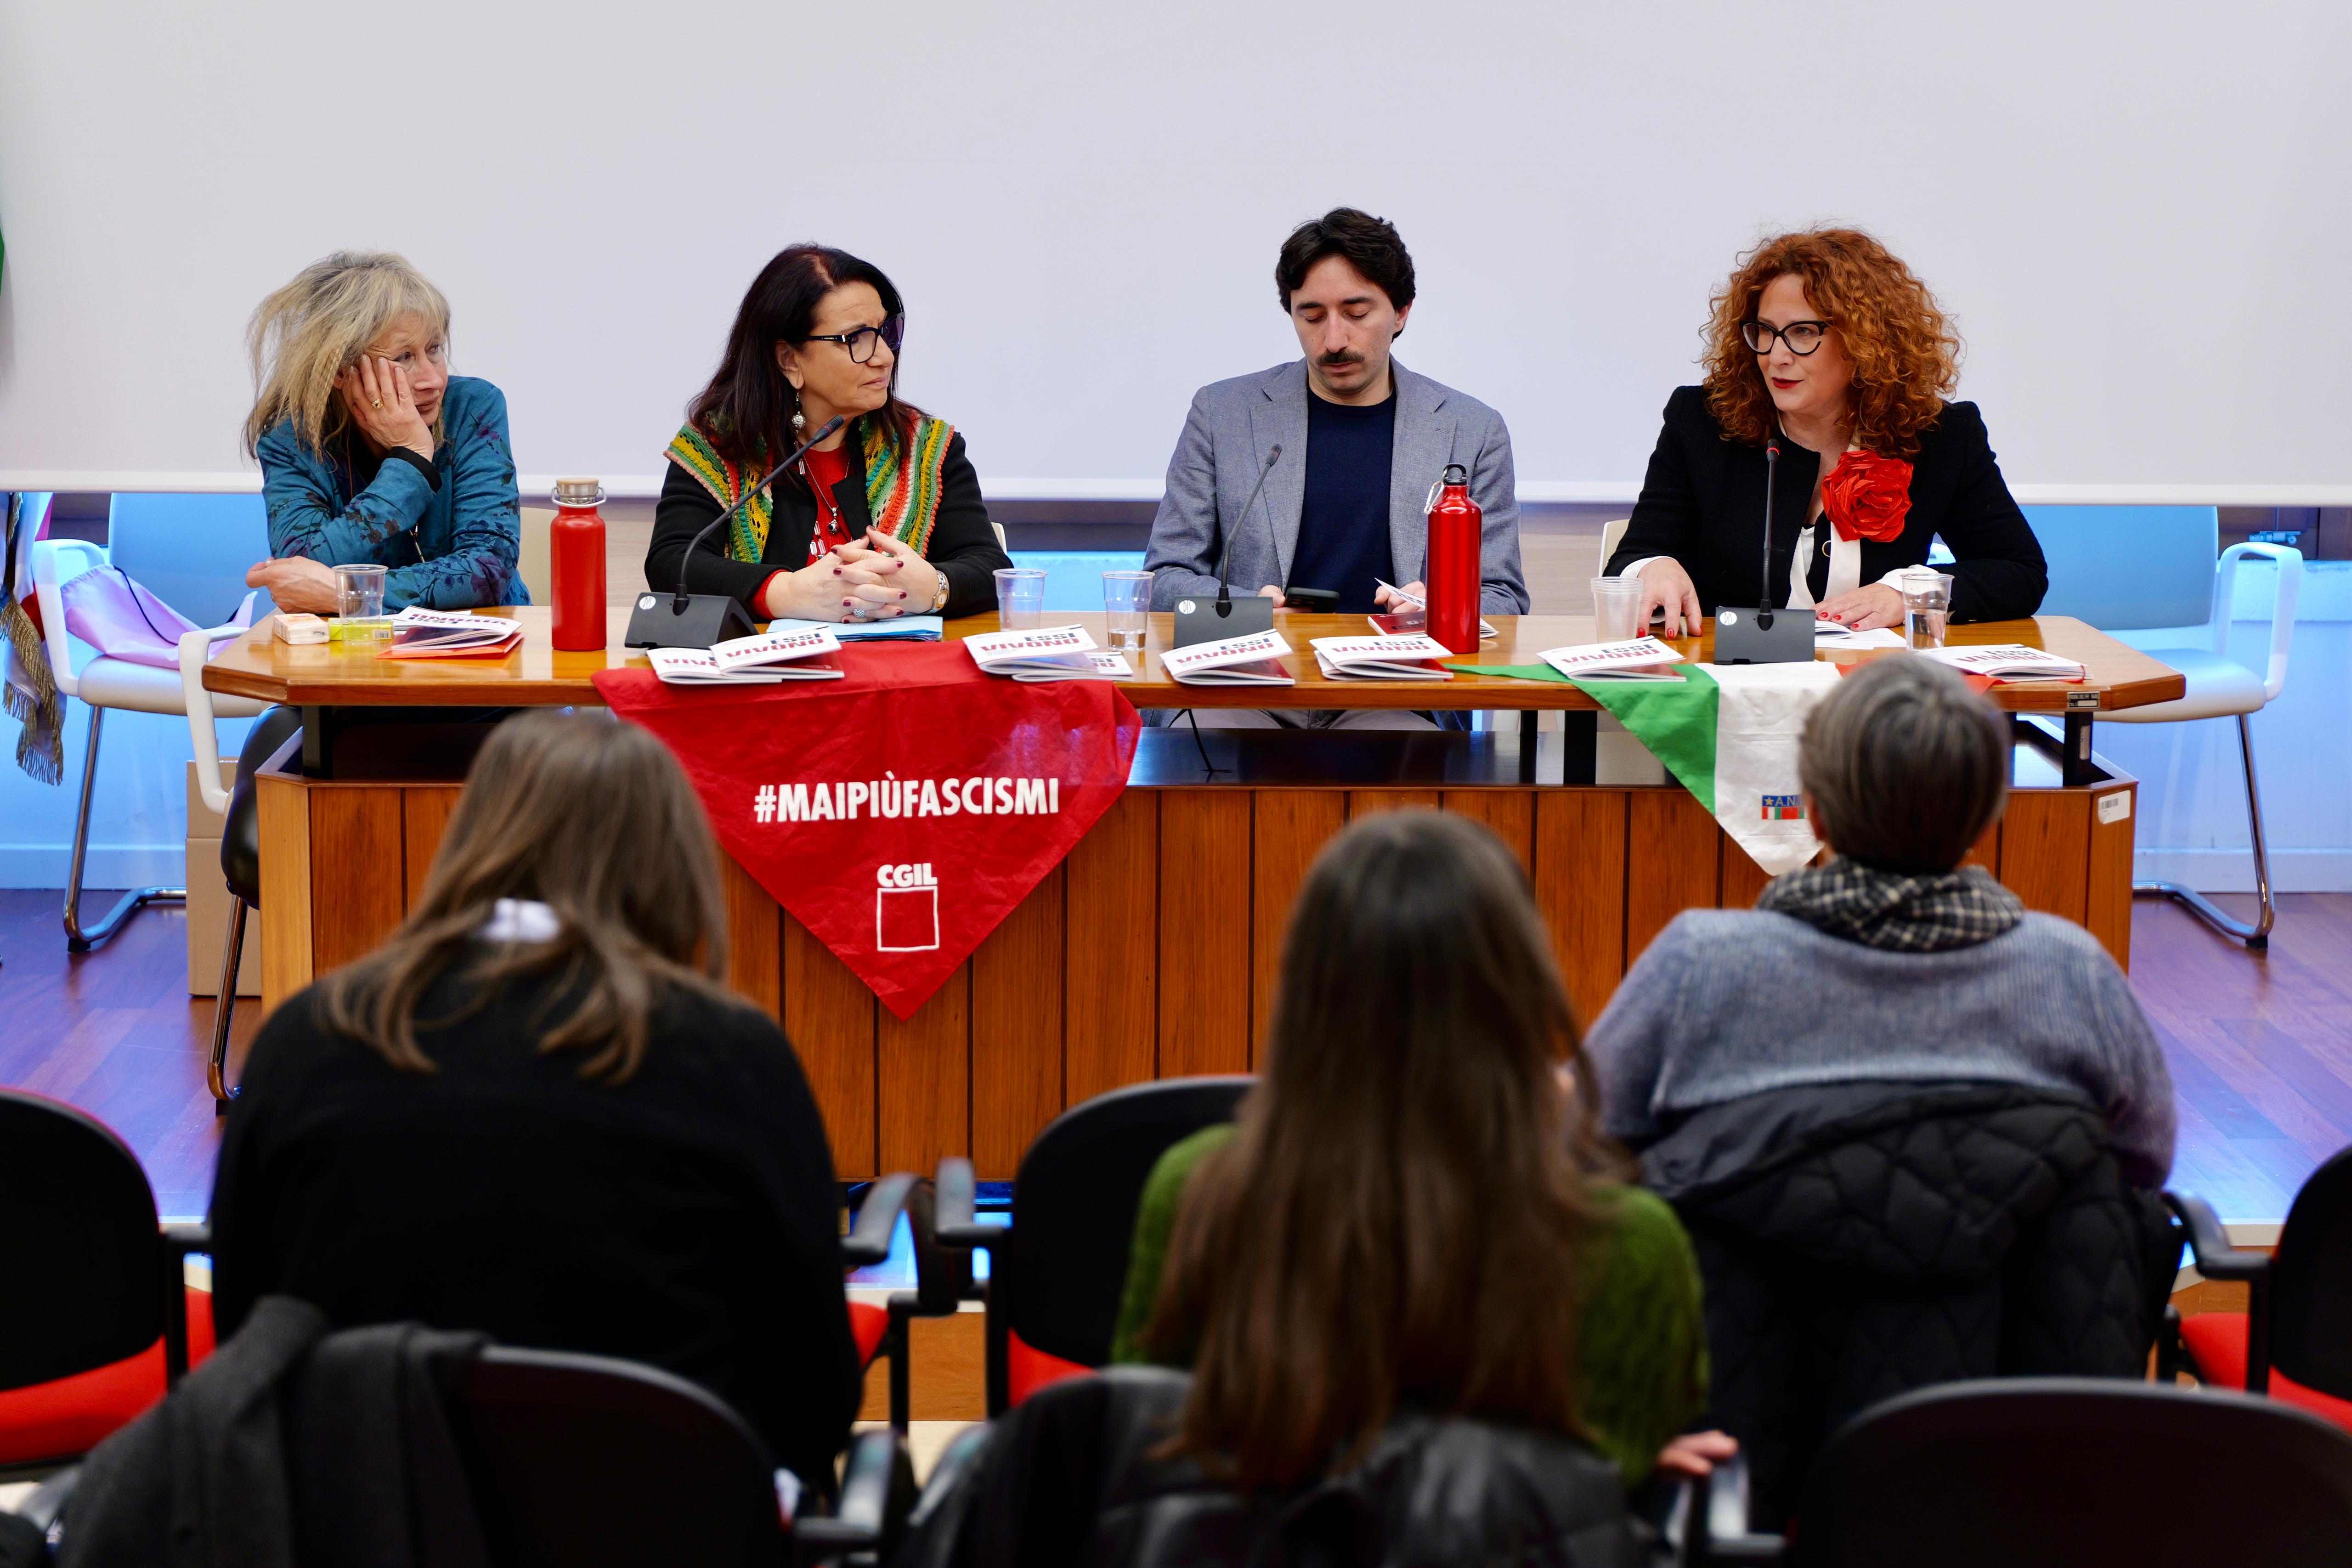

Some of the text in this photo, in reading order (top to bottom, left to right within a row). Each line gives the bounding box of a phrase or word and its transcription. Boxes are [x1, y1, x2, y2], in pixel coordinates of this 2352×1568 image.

[770, 633, 821, 644] ESSI
[1024, 633, 1075, 641] ESSI
[725, 639, 824, 657] VIVONO
[980, 638, 1080, 651] VIVONO
[1219, 638, 1270, 650] ESSI
[1601, 644, 1653, 653] ESSI
[1176, 643, 1274, 663] VIVONO
[1561, 649, 1661, 663] VIVONO
[754, 771, 1058, 823] #MAIPIÙFASCISMI
[877, 863, 938, 887] CGIL
